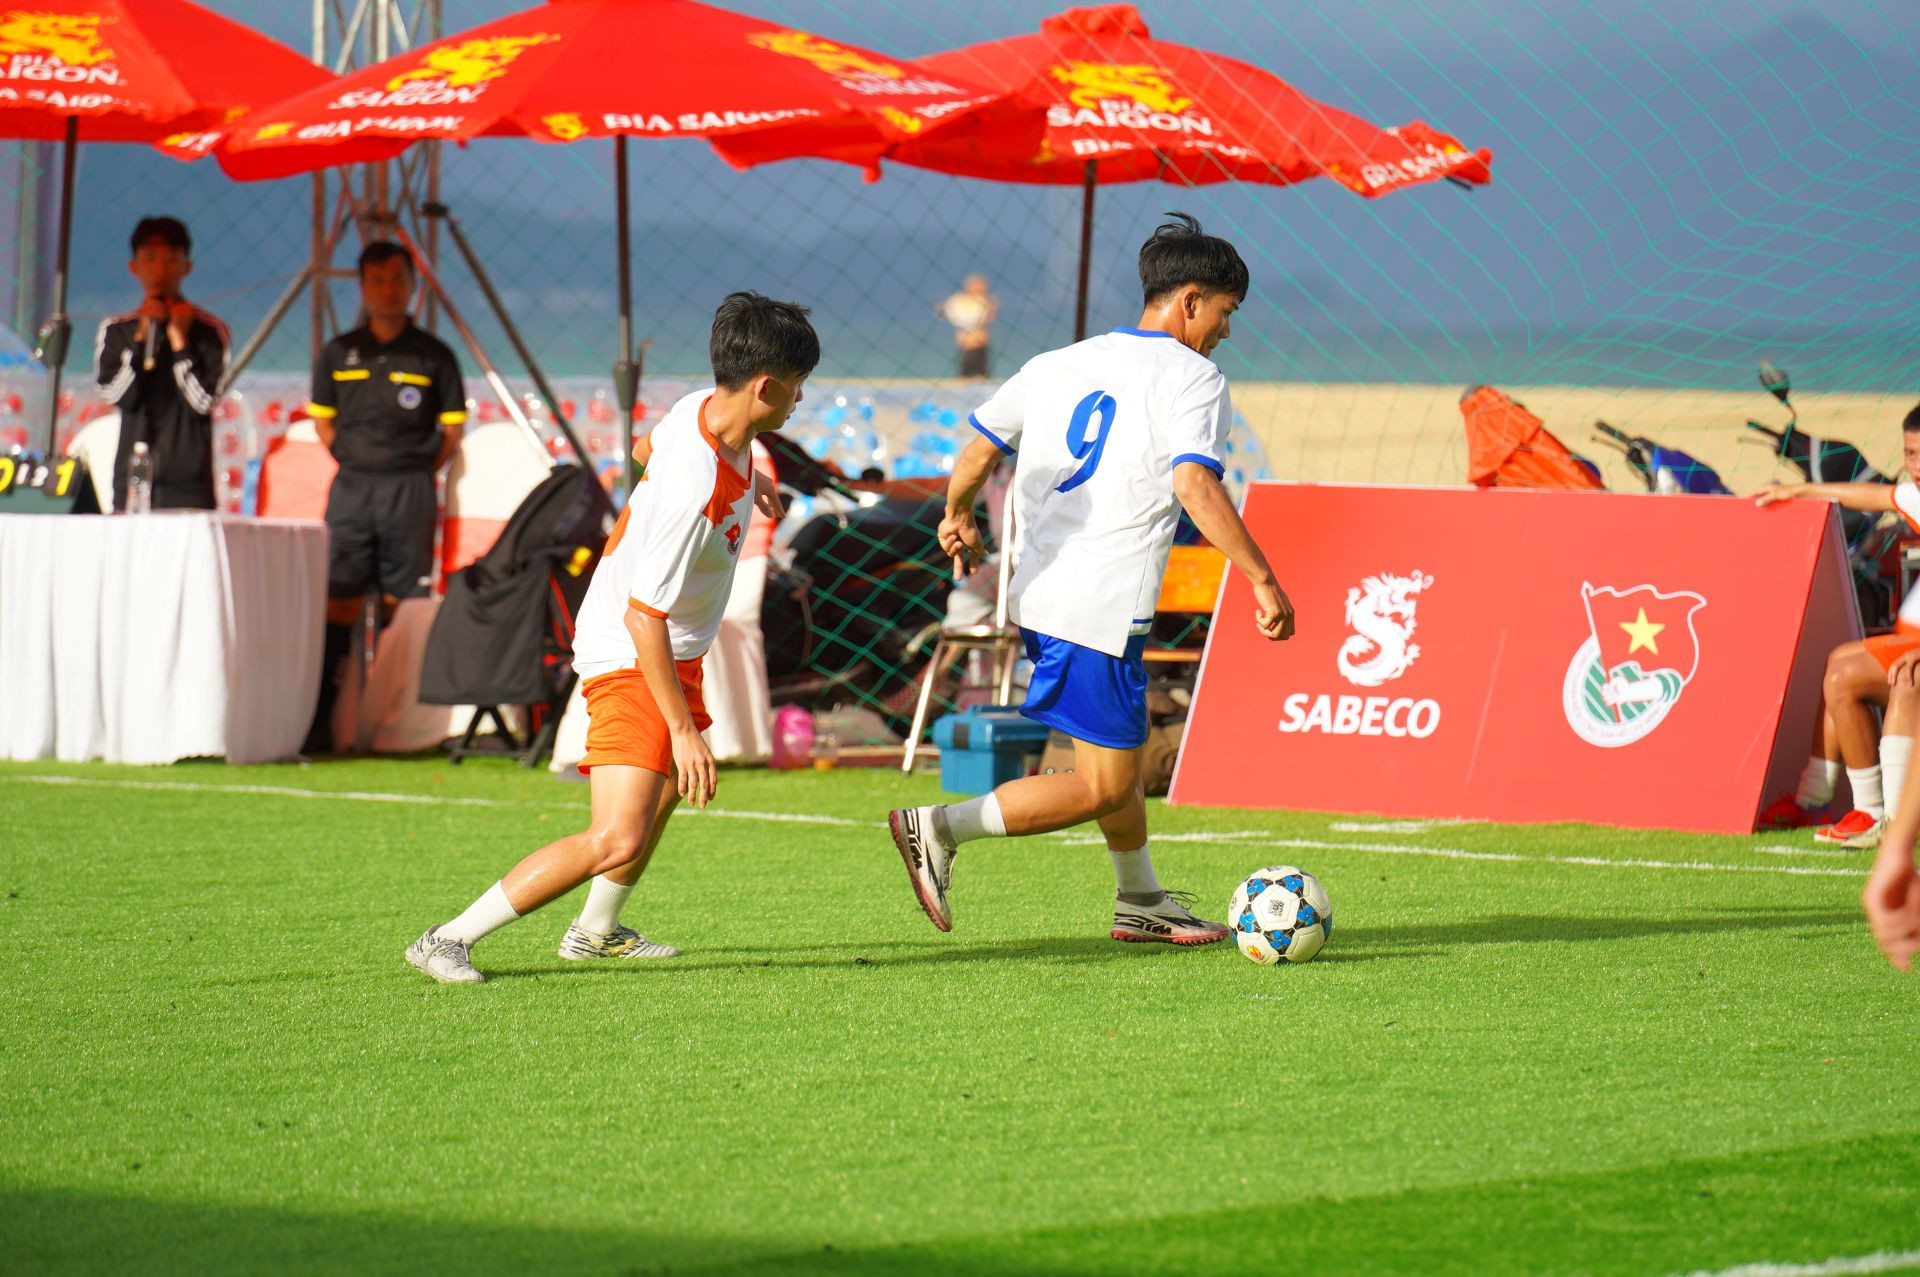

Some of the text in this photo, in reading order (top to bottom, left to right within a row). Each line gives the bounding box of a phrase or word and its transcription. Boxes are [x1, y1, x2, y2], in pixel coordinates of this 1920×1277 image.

[602, 113, 673, 131] BIA
[1046, 107, 1213, 136] SAIGON
[1054, 390, 1117, 493] 9
[55, 458, 76, 497] 1
[1278, 693, 1441, 739] SABECO
